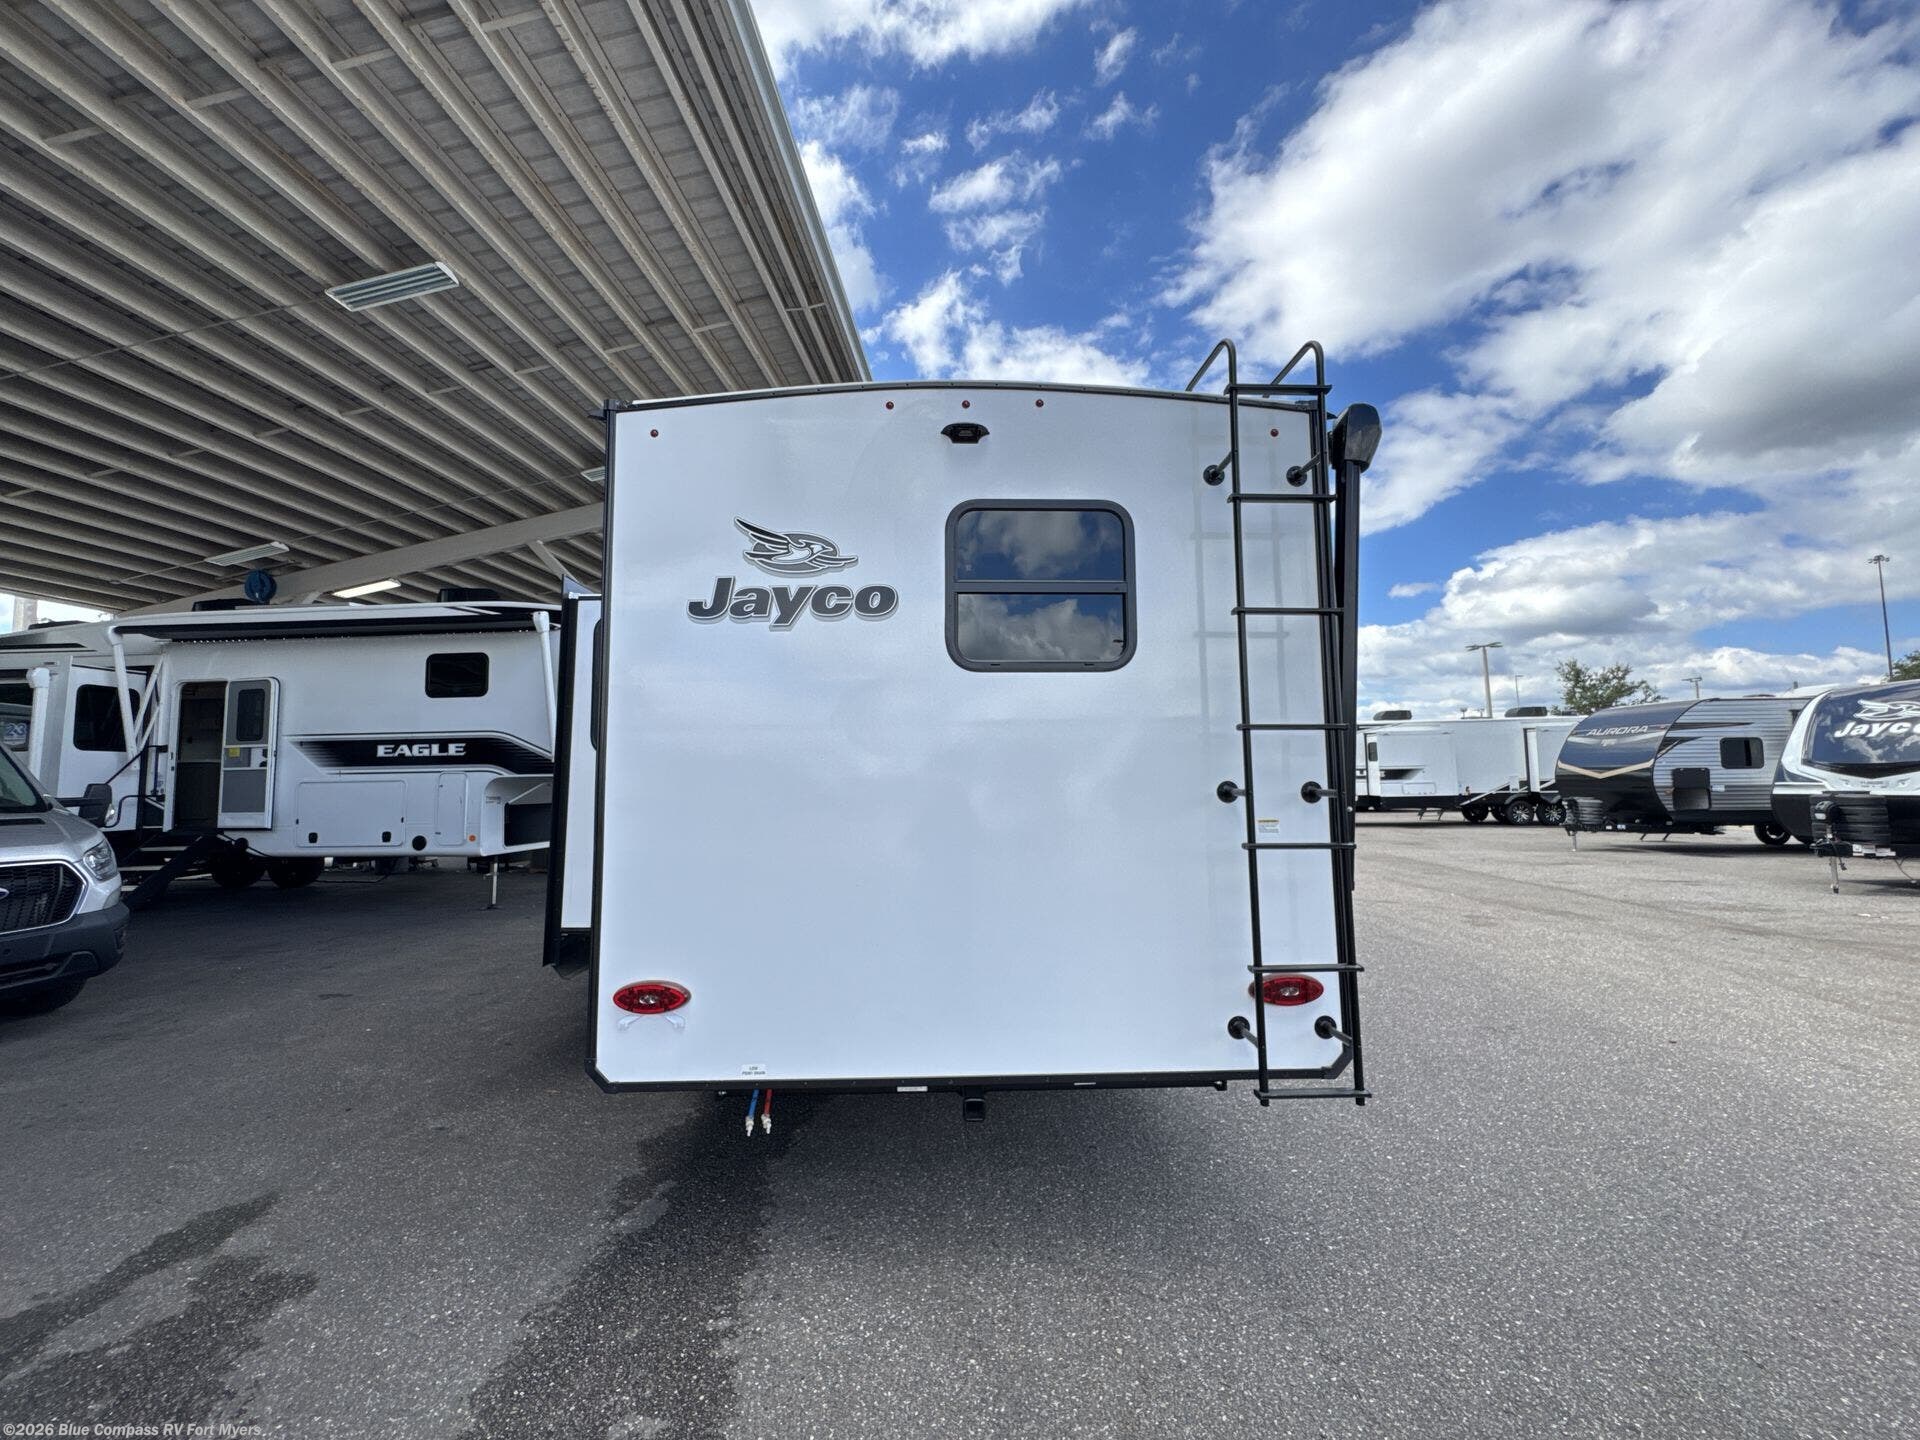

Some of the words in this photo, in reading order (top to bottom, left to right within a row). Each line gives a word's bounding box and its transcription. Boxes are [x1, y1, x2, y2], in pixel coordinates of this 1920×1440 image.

[687, 575, 899, 631] Jayco
[1586, 725, 1649, 736] AURORA
[376, 743, 466, 757] EAGLE
